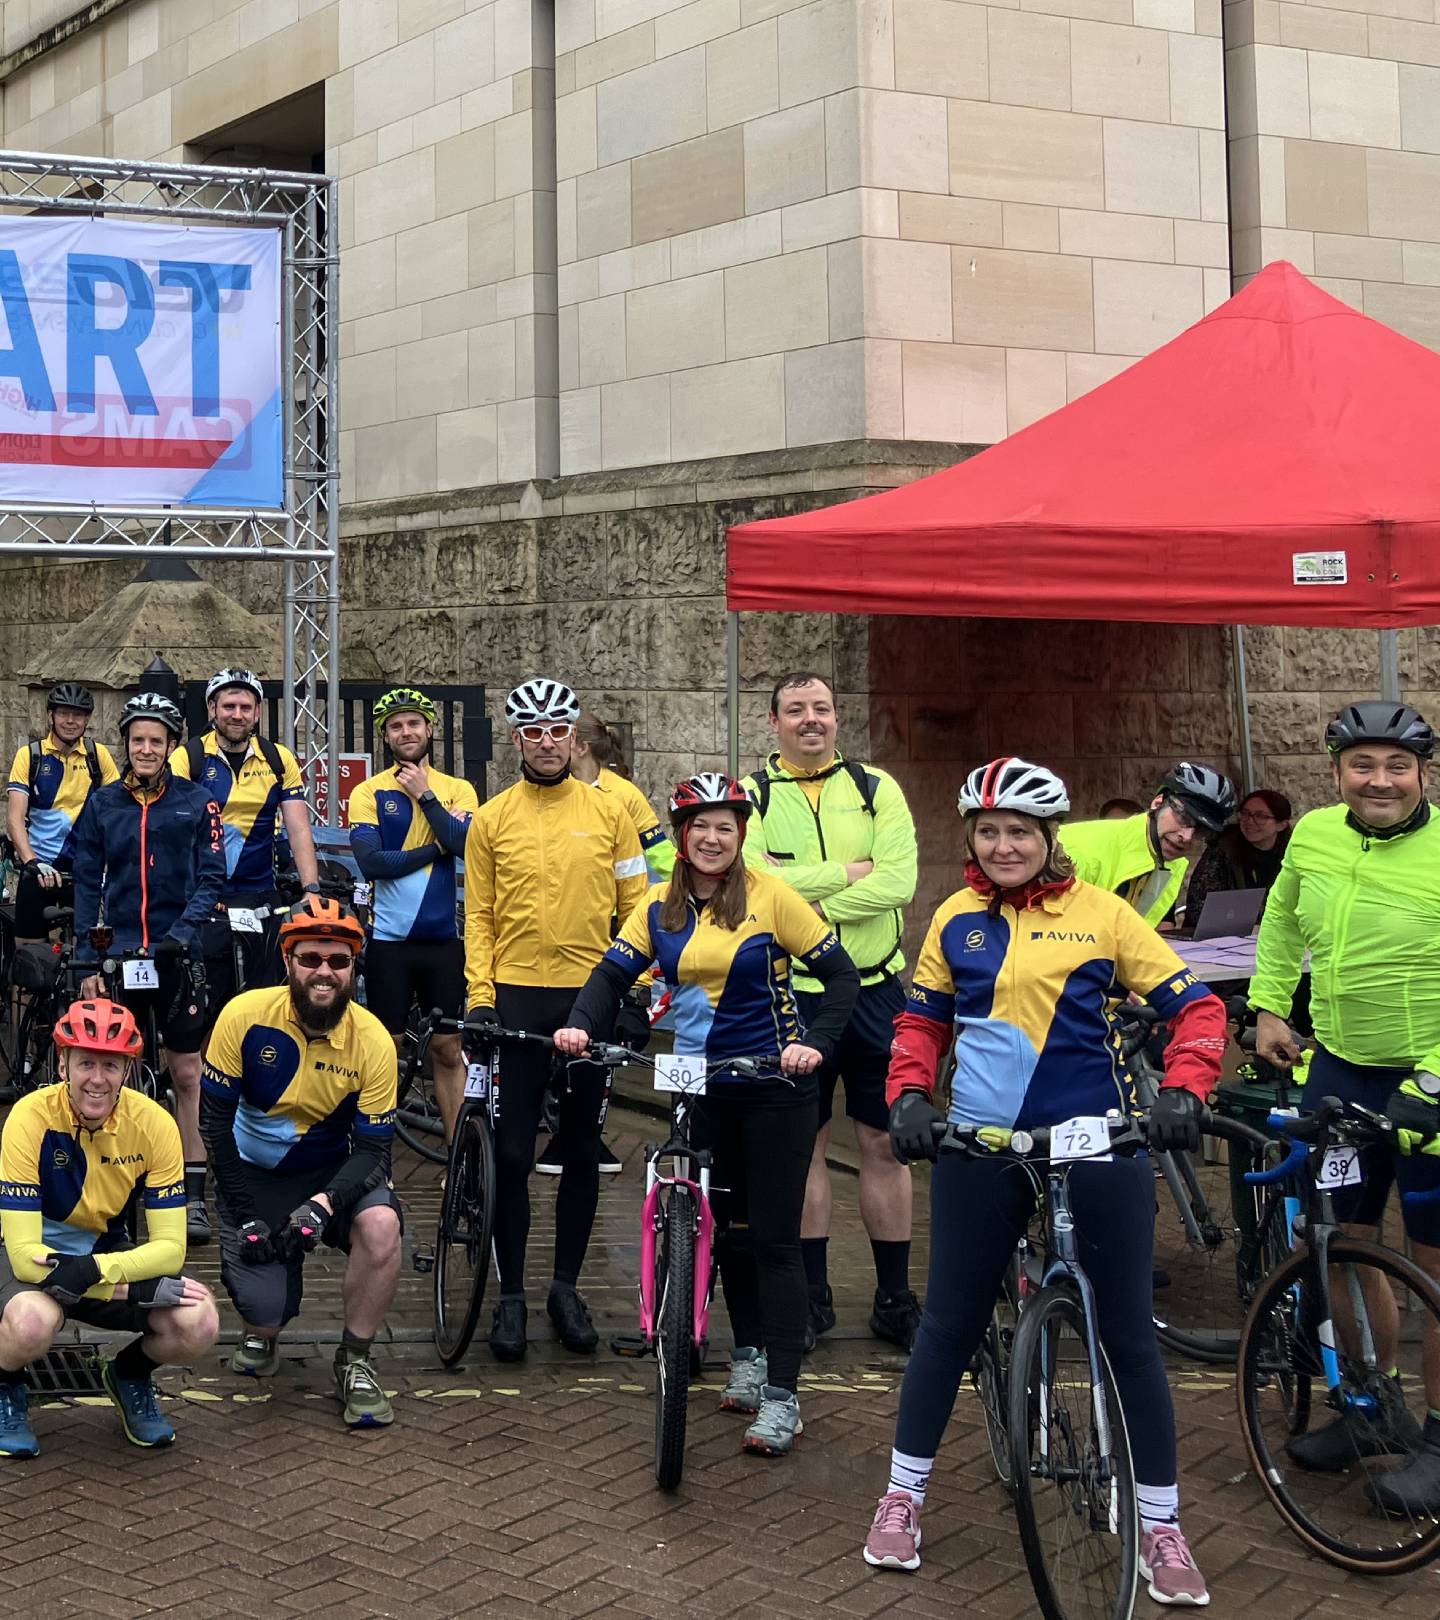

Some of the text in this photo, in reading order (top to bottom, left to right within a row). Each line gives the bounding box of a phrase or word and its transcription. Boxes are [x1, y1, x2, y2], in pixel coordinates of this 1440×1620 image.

[1046, 930, 1096, 944] AVIVA
[134, 970, 149, 983] 14
[326, 1064, 360, 1080] AVIVA
[669, 1068, 692, 1084] 80
[470, 1076, 484, 1091] 71
[1064, 1133, 1093, 1151] 72
[112, 1153, 145, 1166] AVIVA
[1328, 1159, 1349, 1178] 38
